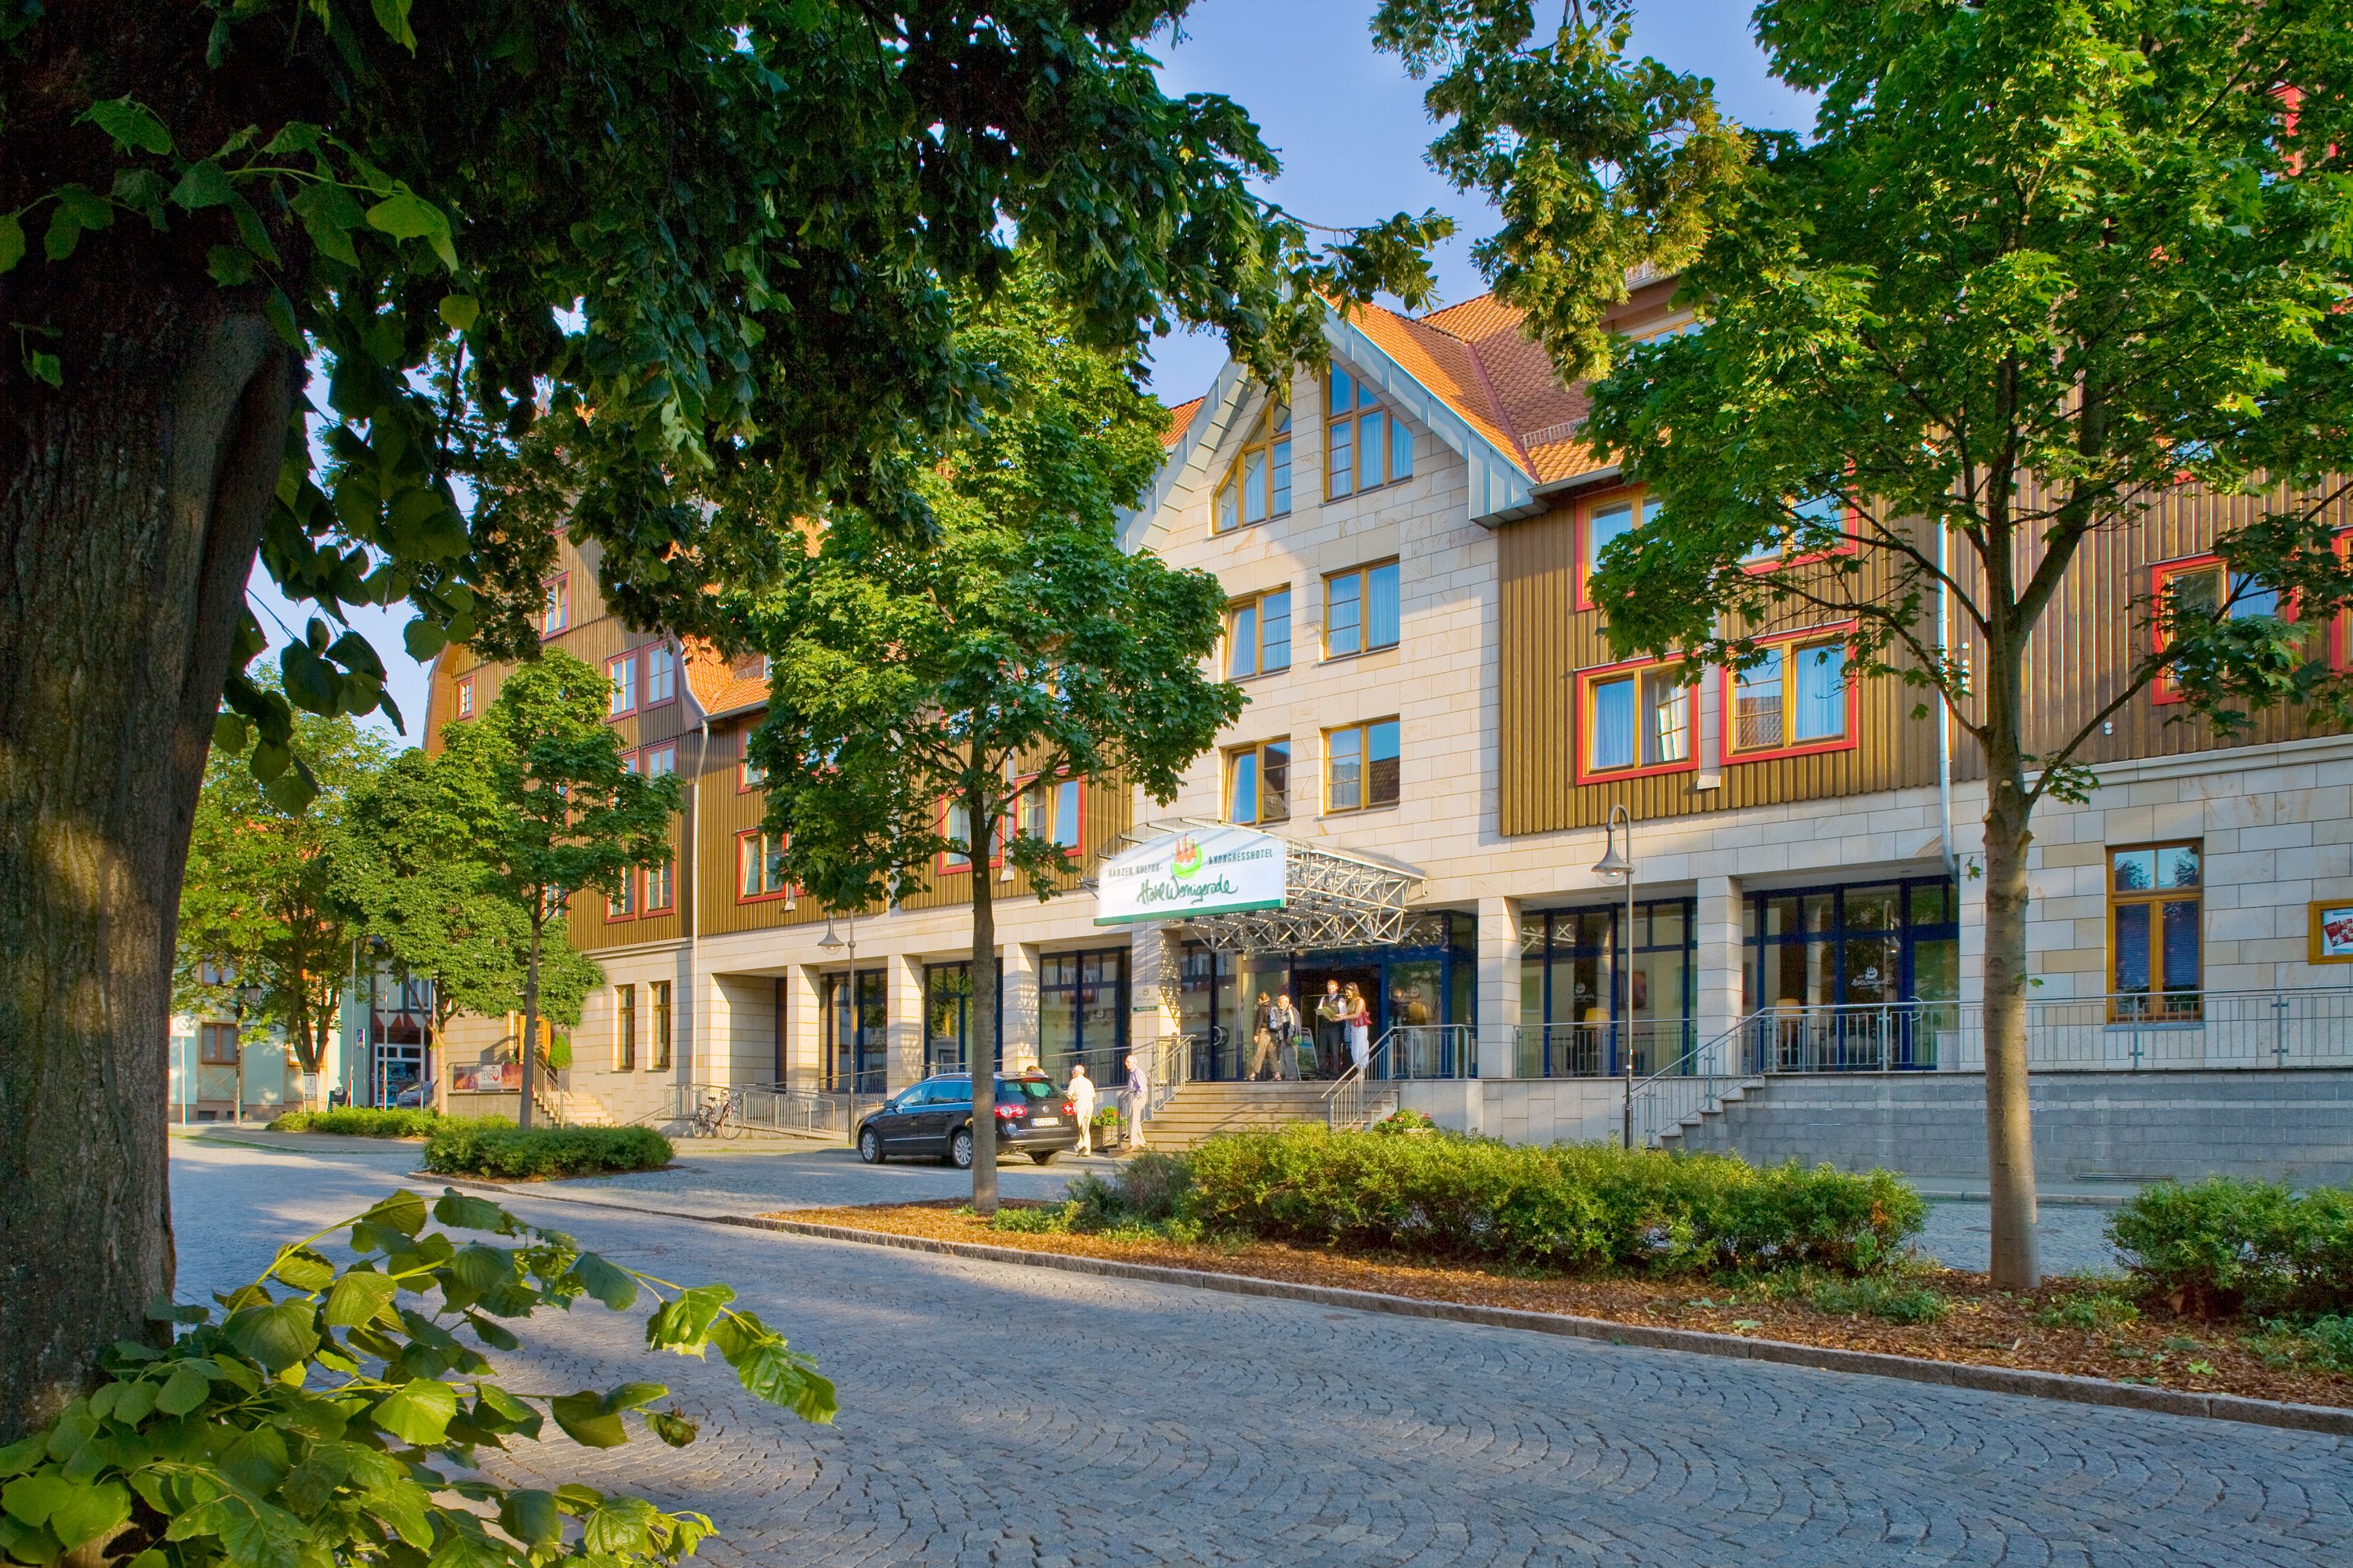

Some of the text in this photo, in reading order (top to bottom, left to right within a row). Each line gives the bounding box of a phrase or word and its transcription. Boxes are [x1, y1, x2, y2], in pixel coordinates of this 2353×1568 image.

[1214, 848, 1273, 864] KONGRESSHOTEL
[1109, 866, 1133, 877] HARZER
[1136, 875, 1239, 906] Hotel Wernigerode
[358, 1030, 363, 1041] P
